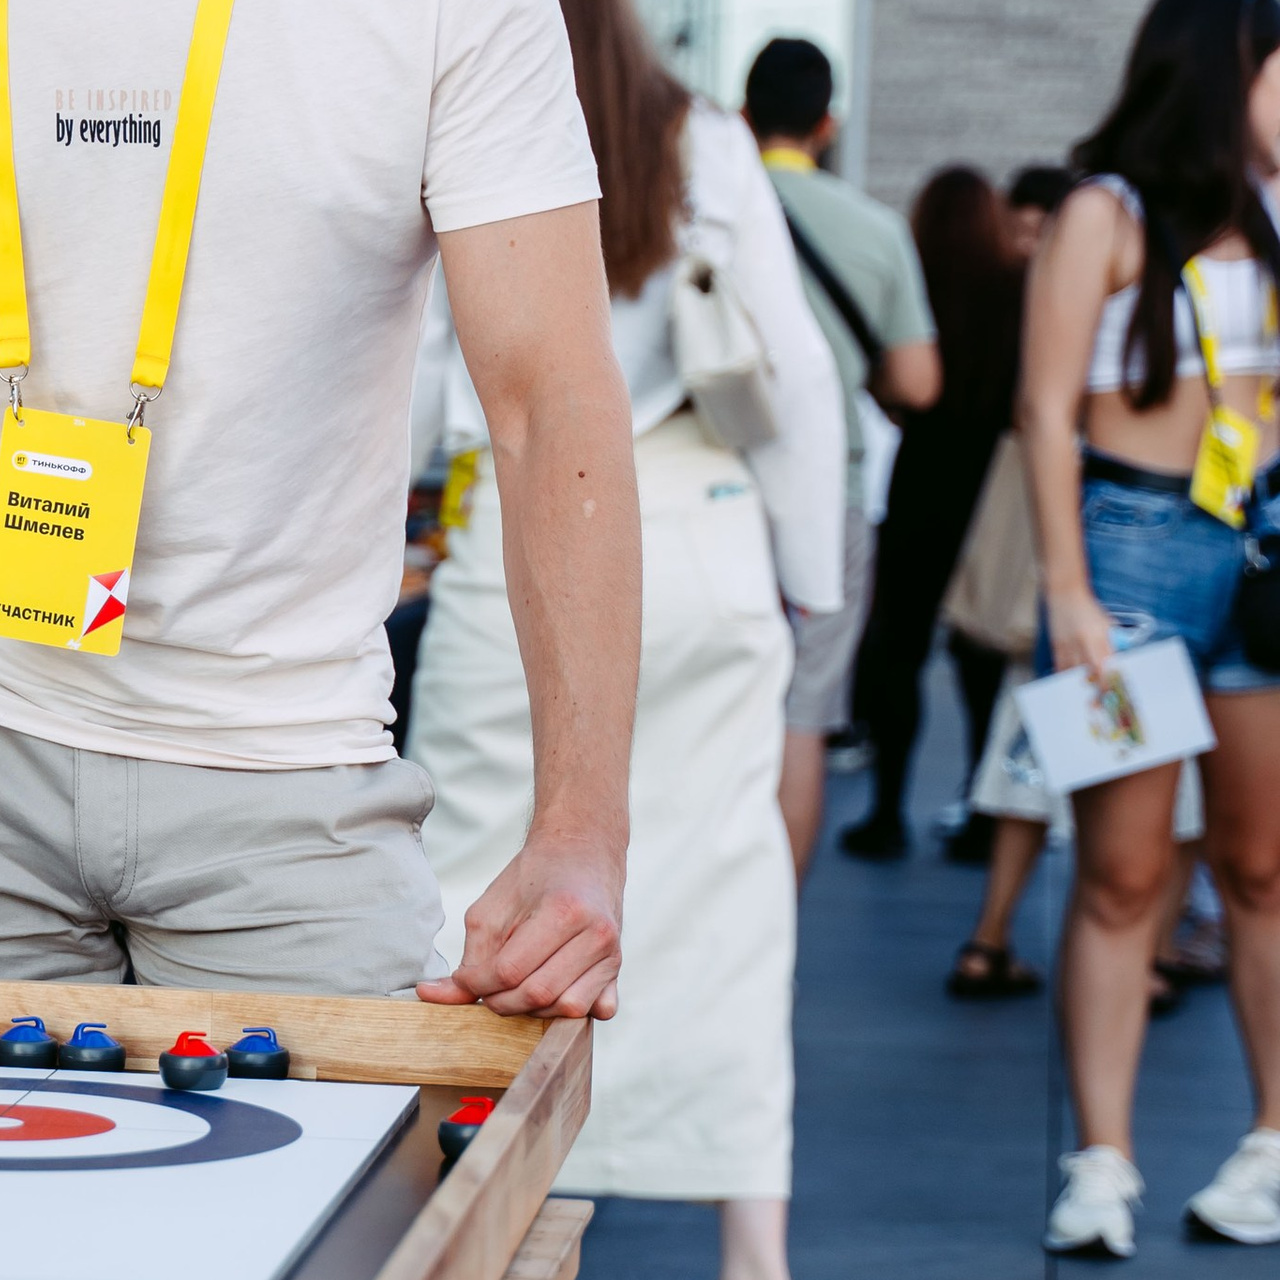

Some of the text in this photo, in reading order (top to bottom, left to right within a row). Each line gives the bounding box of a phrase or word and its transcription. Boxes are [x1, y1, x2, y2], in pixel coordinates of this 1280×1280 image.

[55, 89, 172, 111] BE INSPIRED
[56, 113, 161, 147] by everything
[32, 459, 86, 473] ТИНЬКОФФ
[7, 491, 90, 519] Виталий
[4, 514, 85, 541] Шмелев
